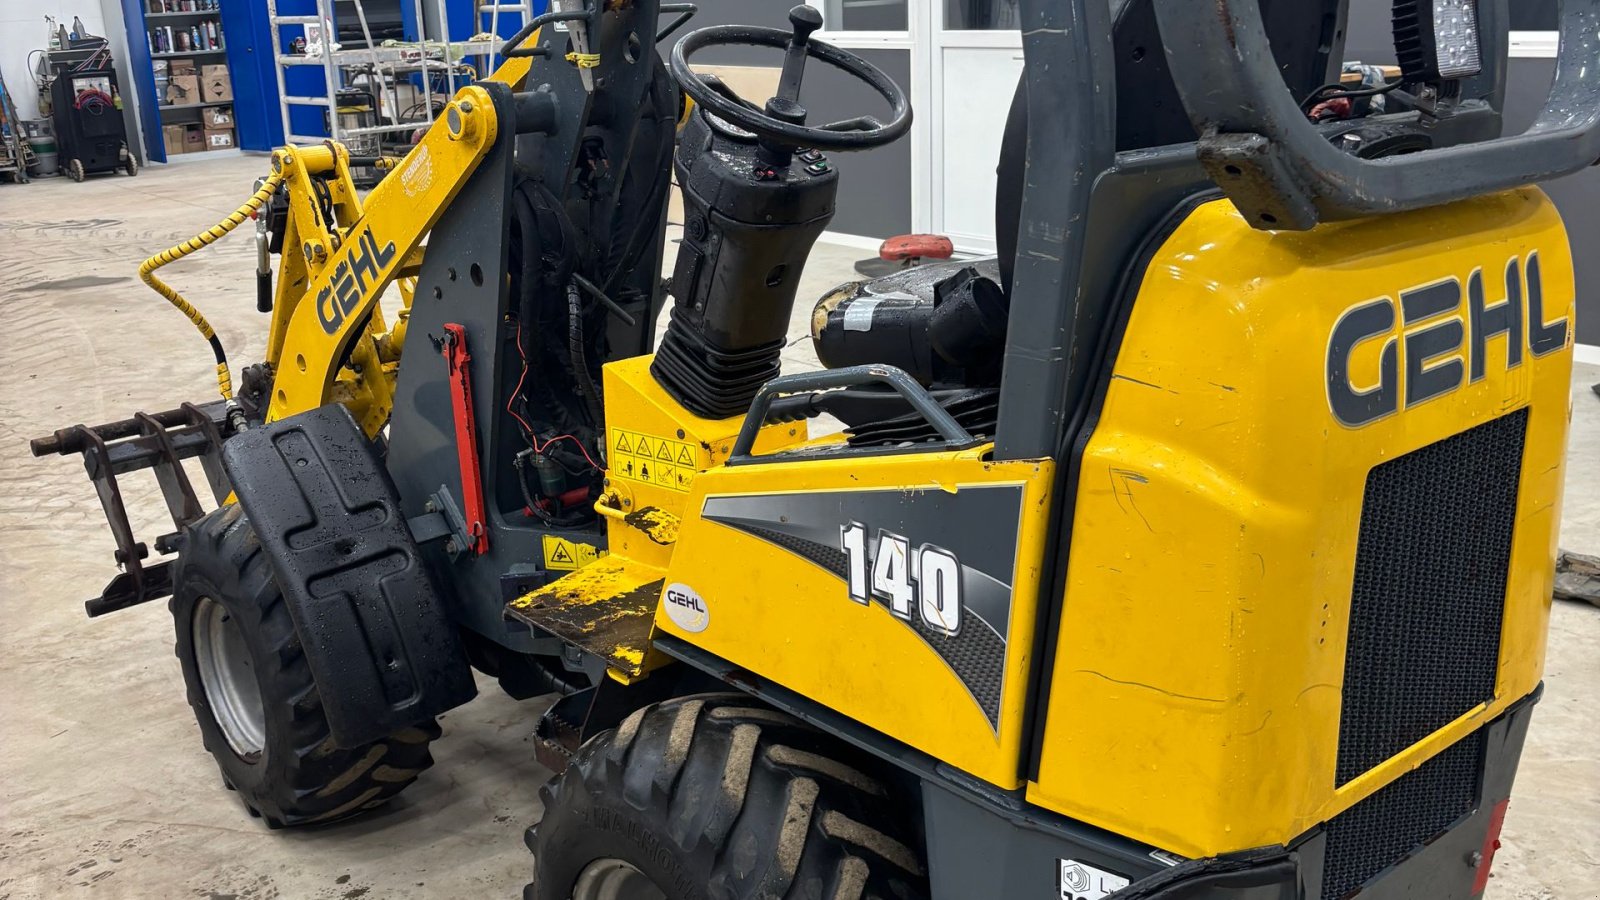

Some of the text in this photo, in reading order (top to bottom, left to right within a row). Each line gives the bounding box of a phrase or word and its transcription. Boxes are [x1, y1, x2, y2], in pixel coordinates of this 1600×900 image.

[316, 224, 396, 336] GEHL
[1325, 250, 1569, 429] GEHL
[668, 590, 704, 613] GEHL
[840, 520, 963, 637] 140
